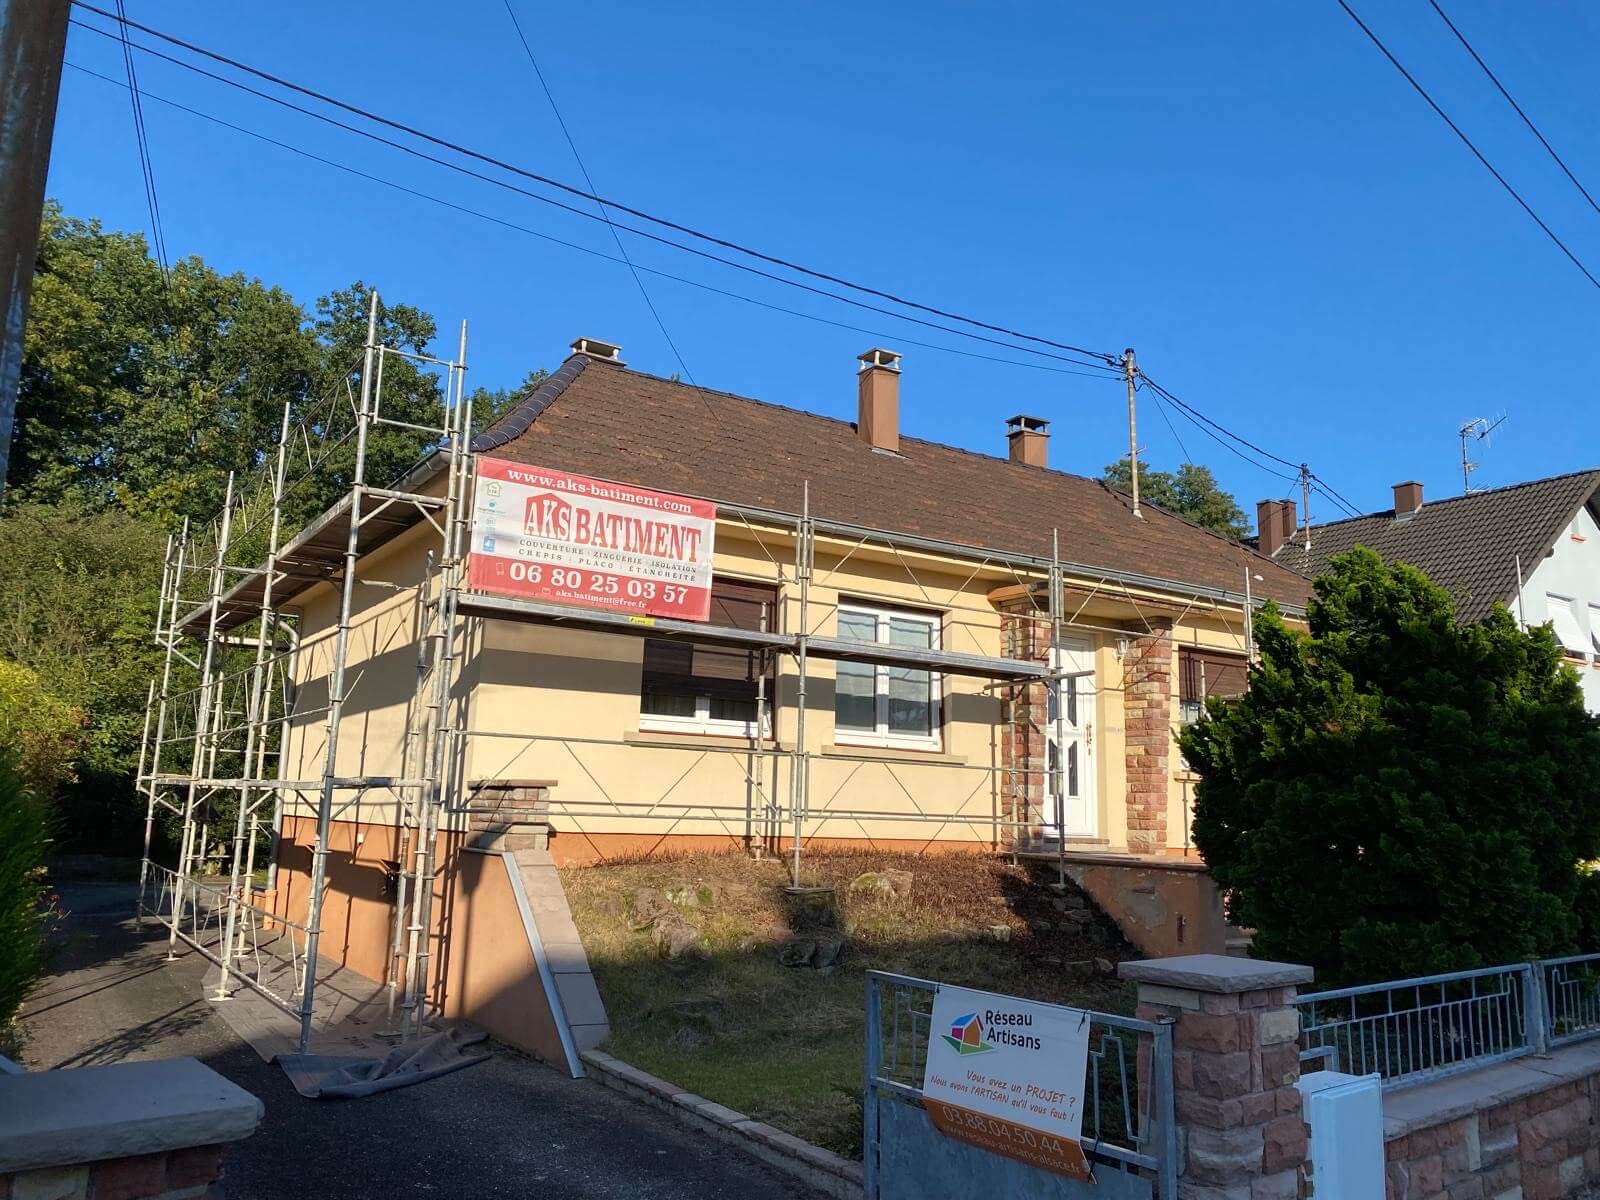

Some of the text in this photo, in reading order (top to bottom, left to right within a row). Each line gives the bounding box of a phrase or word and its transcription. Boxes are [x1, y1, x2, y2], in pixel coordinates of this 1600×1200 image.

[508, 468, 692, 514] www.aks-batiment.com
[526, 499, 702, 562] AKS BATIMENT
[520, 539, 697, 573] COUVERTURE ZINGUERIE ISOLATION
[578, 558, 614, 569] PLACO
[510, 562, 688, 604] 06 80 25 03 57
[556, 589, 647, 610] aks.batiment@free.fr
[985, 1010, 1032, 1026] Réseau
[987, 1027, 1041, 1050] Artisans
[931, 1075, 947, 1087] Nous
[950, 1081, 968, 1093] avons
[971, 1084, 1010, 1104] l'ARTISAN
[1012, 1098, 1027, 1110] qu'il
[1030, 1104, 1047, 1115] vous
[1050, 1108, 1068, 1120] faut
[966, 1070, 1076, 1108] Vous avez un PROJET ?
[943, 1105, 1065, 1156] 03.88.04.50.44
